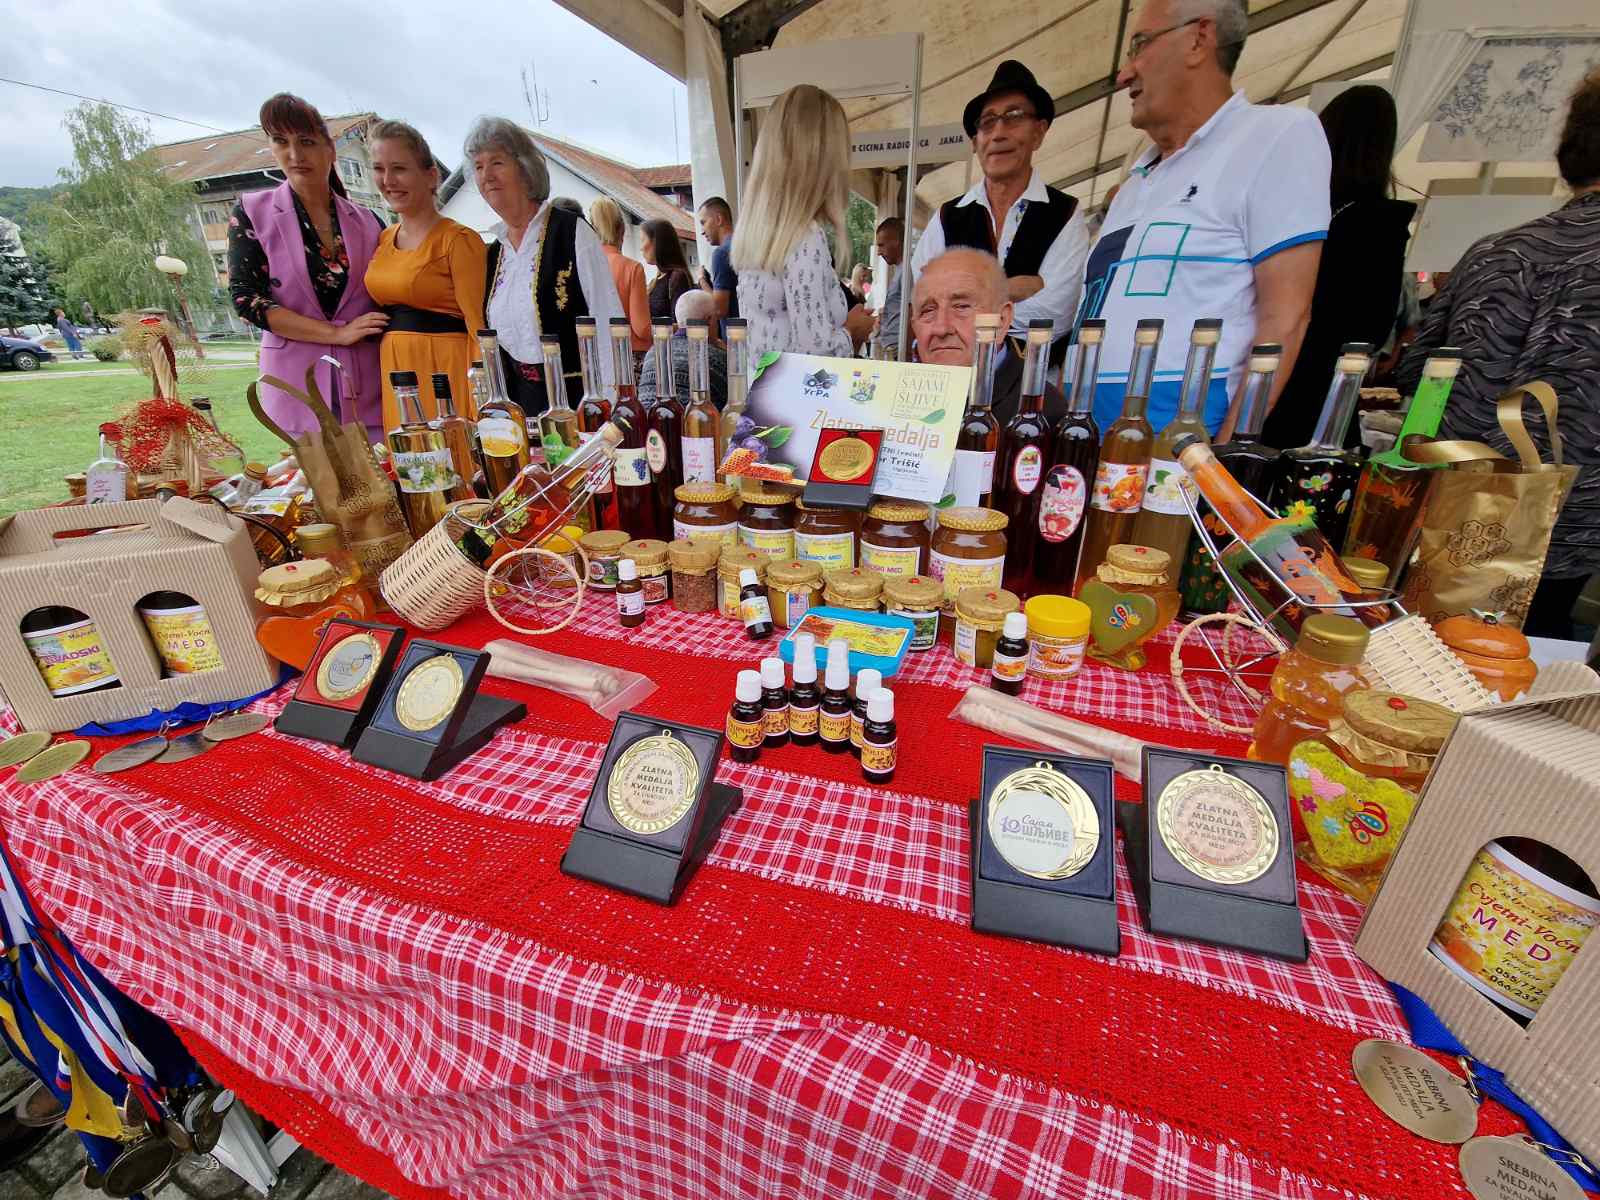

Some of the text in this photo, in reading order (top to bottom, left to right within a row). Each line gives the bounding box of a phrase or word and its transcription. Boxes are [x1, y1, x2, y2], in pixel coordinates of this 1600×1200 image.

[858, 142, 885, 152] CICINA
[938, 135, 964, 146] JANJA
[890, 457, 921, 470] Trišić
[167, 639, 206, 650] MED
[641, 765, 673, 777] ZLATNA
[631, 782, 675, 795] KVALITETA
[636, 775, 673, 786] MEDALJA
[1196, 802, 1239, 818] ZLATNA
[1192, 811, 1243, 829] MEDALJA
[1022, 824, 1070, 843] ШЉИВЕ
[1188, 821, 1248, 840] KVALITETA
[1472, 906, 1552, 962] MED
[1400, 1064, 1436, 1113] MEDALJA
[1417, 1066, 1452, 1113] SREBRNA
[1498, 1156, 1559, 1192] SREBRNA
